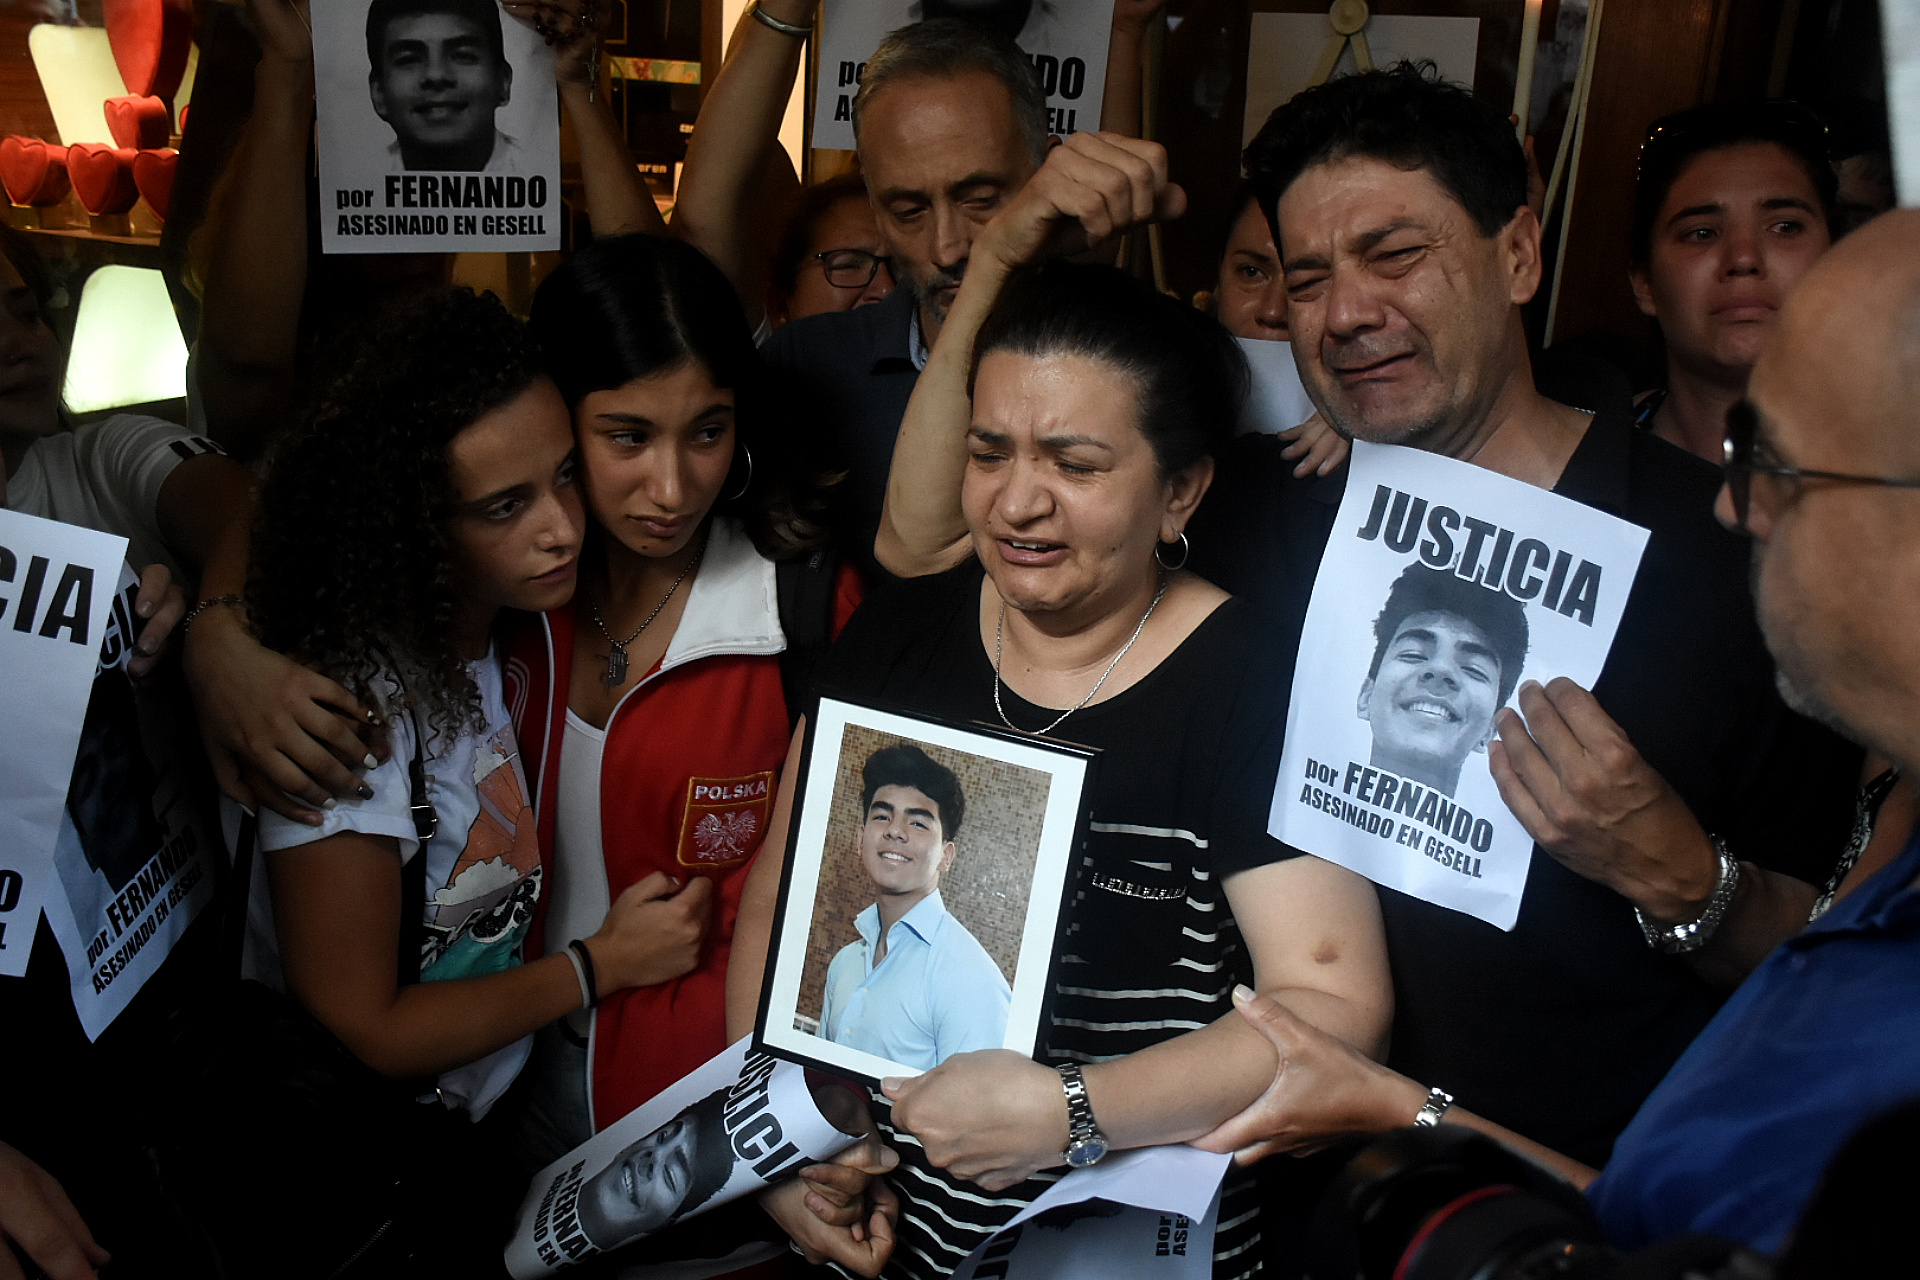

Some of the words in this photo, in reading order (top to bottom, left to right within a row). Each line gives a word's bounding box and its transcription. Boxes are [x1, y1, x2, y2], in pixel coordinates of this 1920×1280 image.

[337, 189, 374, 209] por
[385, 175, 547, 208] FERNANDO
[337, 214, 449, 236] ASESINADO
[454, 215, 477, 235] EN
[482, 214, 547, 236] GESELL
[1357, 484, 1602, 628] JUSTICIA
[695, 780, 768, 800] POLSKA
[1304, 757, 1339, 788] por
[1343, 761, 1494, 853] FERNANDO
[1299, 783, 1395, 839] ASESINADO
[1396, 823, 1424, 851] EN
[1424, 836, 1482, 879] GESELL
[87, 928, 110, 969] por
[106, 824, 198, 938] FERNANDO
[92, 914, 157, 996] ASESINADO
[154, 898, 170, 926] EN
[168, 862, 203, 910] GESELL
[537, 1240, 562, 1267] EN
[1155, 1215, 1172, 1256] por
[1172, 1213, 1190, 1256] ASE
